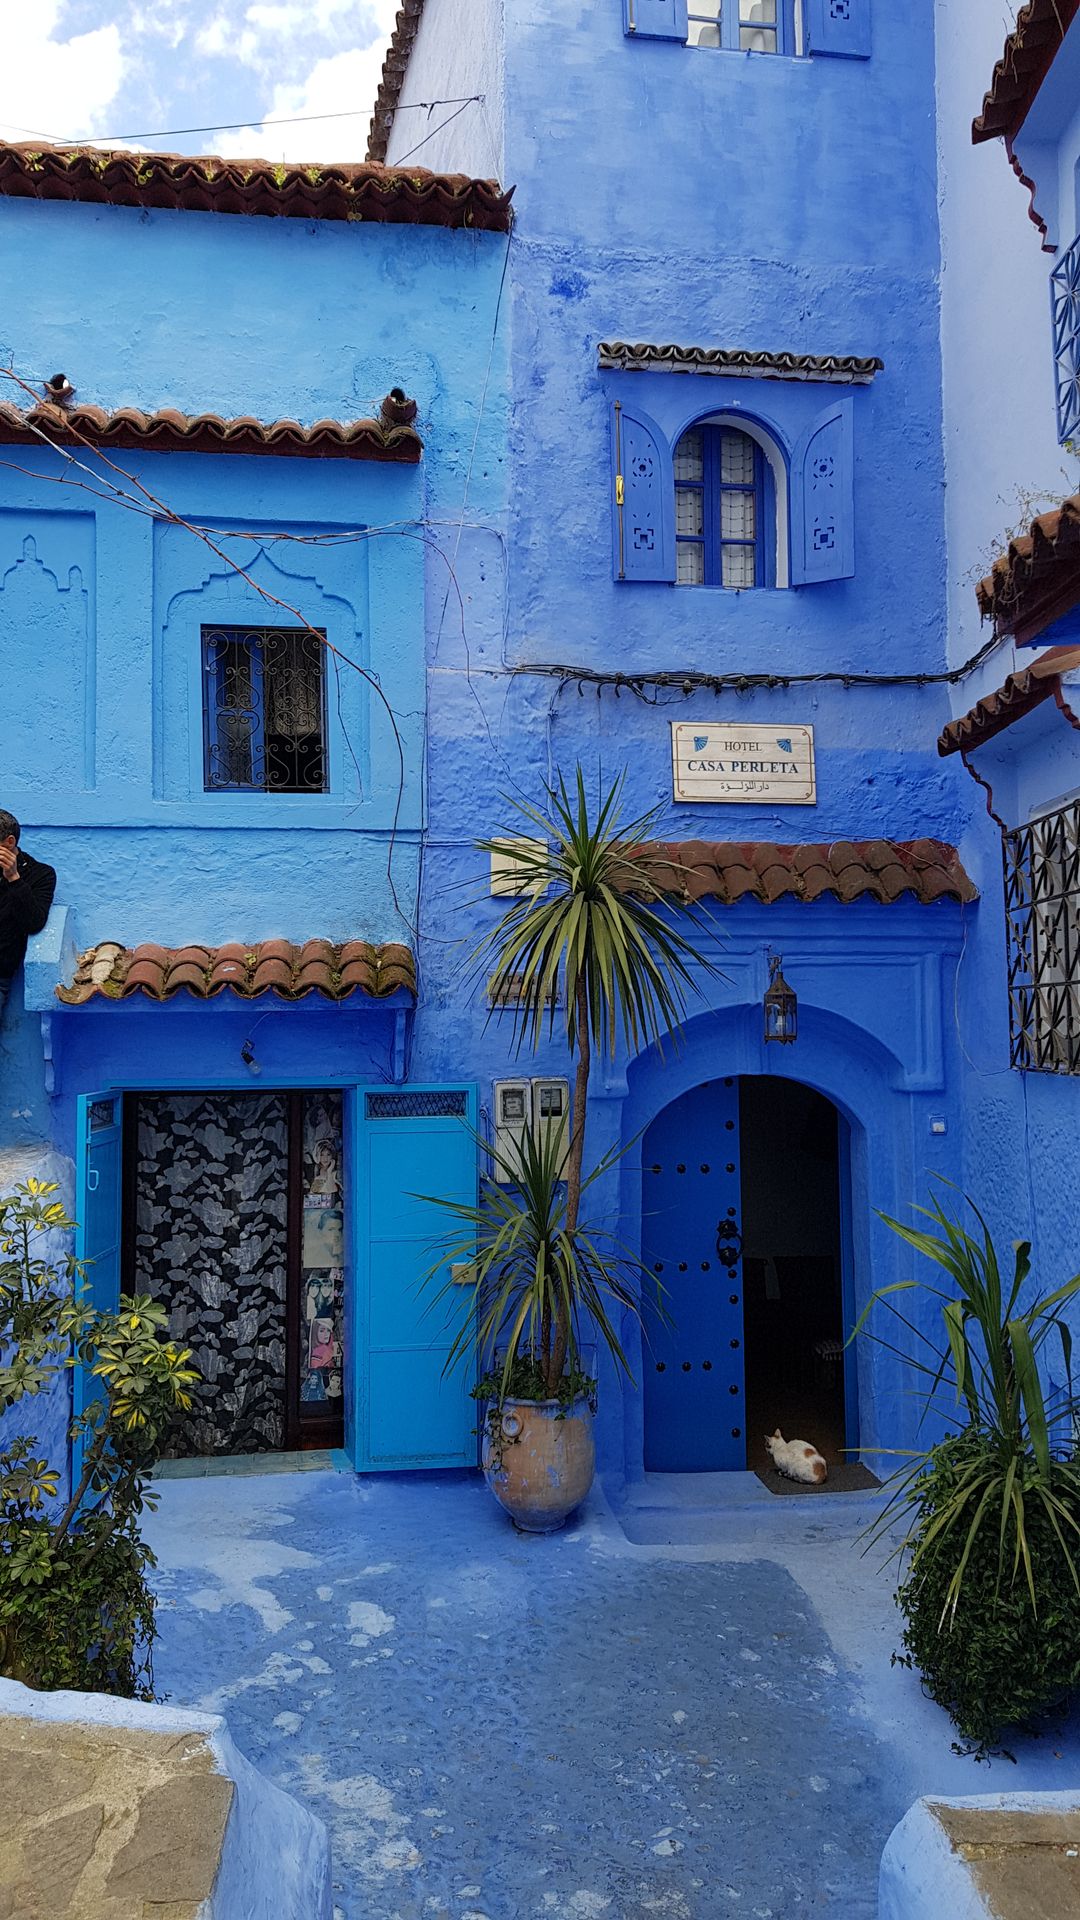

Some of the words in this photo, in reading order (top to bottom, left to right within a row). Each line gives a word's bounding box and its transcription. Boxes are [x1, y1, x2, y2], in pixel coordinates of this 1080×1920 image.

[724, 741, 762, 751] HOTEL
[687, 760, 725, 772] CASA
[731, 761, 799, 773] PERLETA
